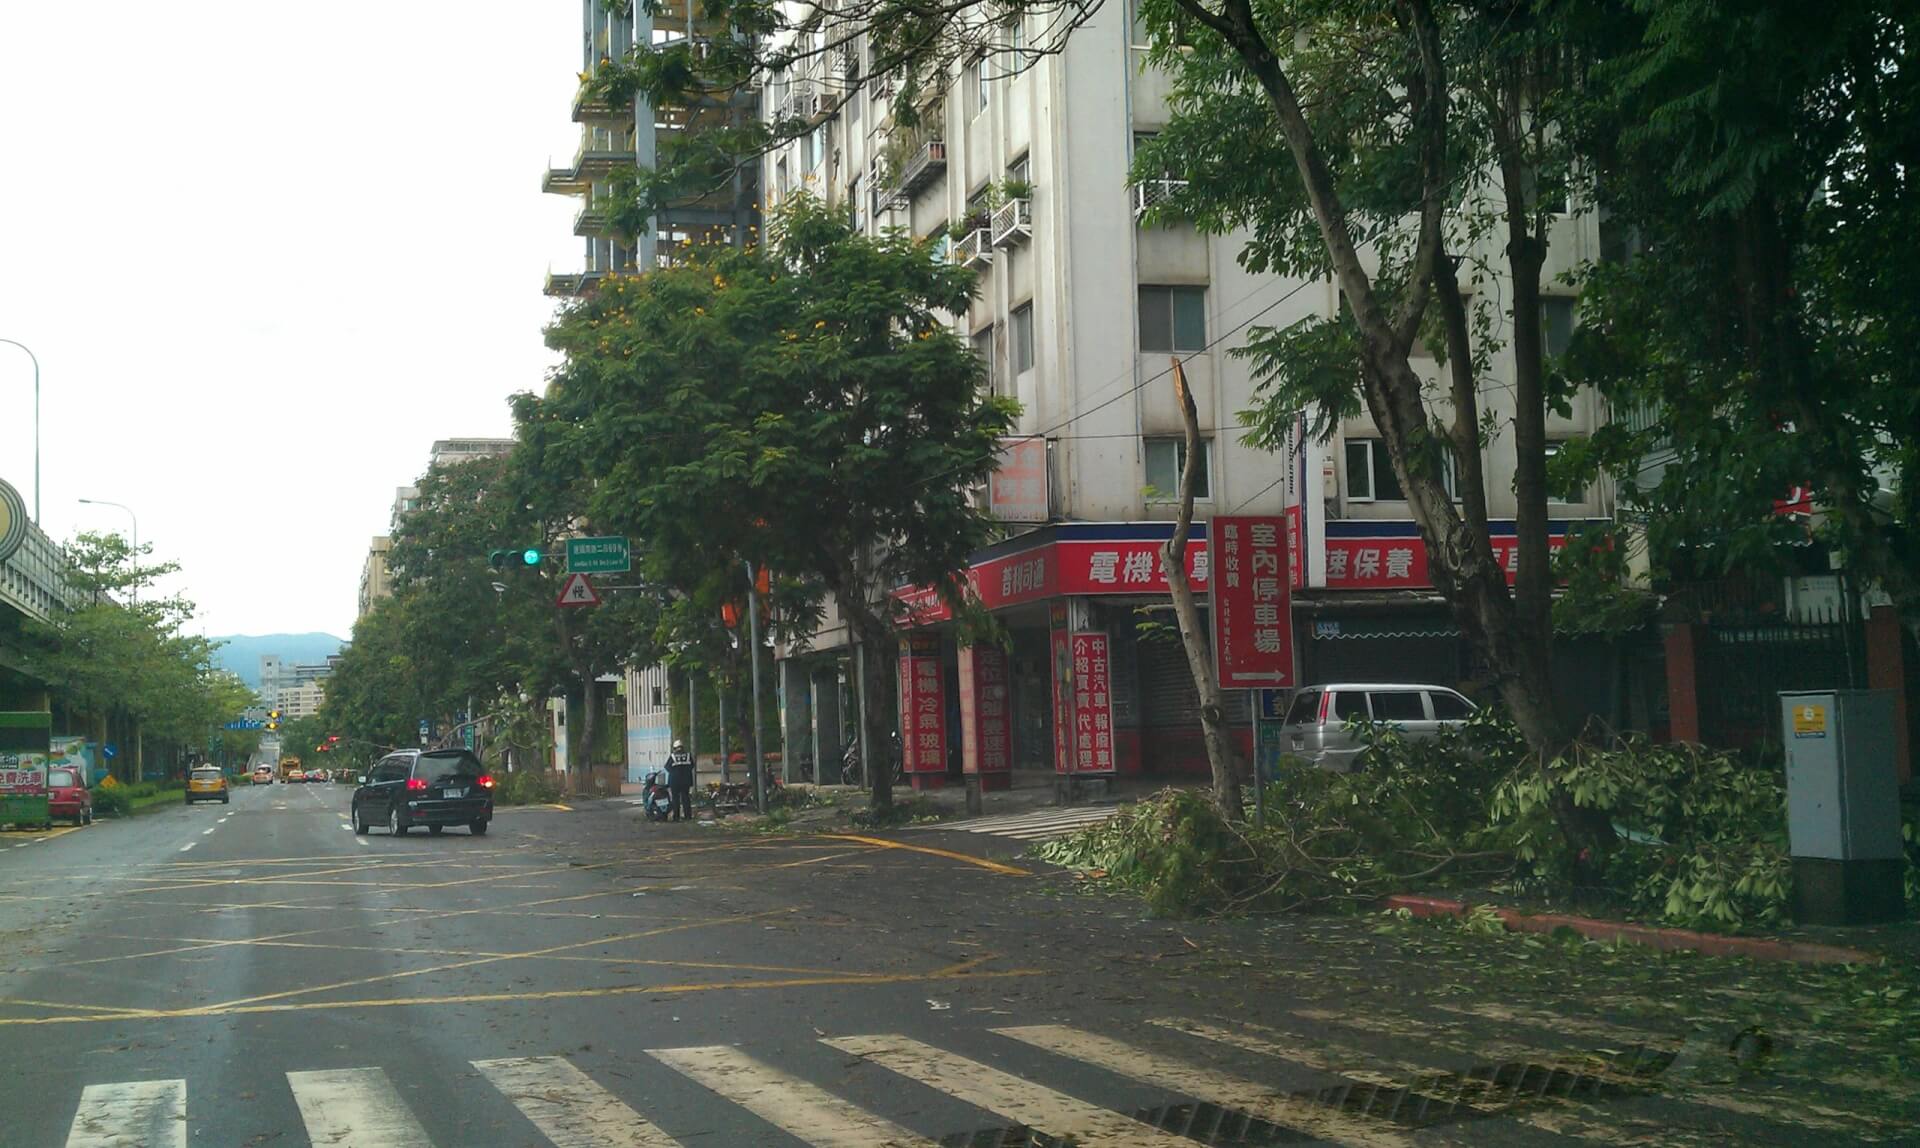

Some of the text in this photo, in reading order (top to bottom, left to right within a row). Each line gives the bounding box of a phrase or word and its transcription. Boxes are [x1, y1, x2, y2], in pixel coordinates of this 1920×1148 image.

[1002, 557, 1044, 597] 普利司通
[1224, 524, 1240, 588] 臨時收費
[572, 585, 585, 599] 慢
[1251, 523, 1281, 653] 室內停車場
